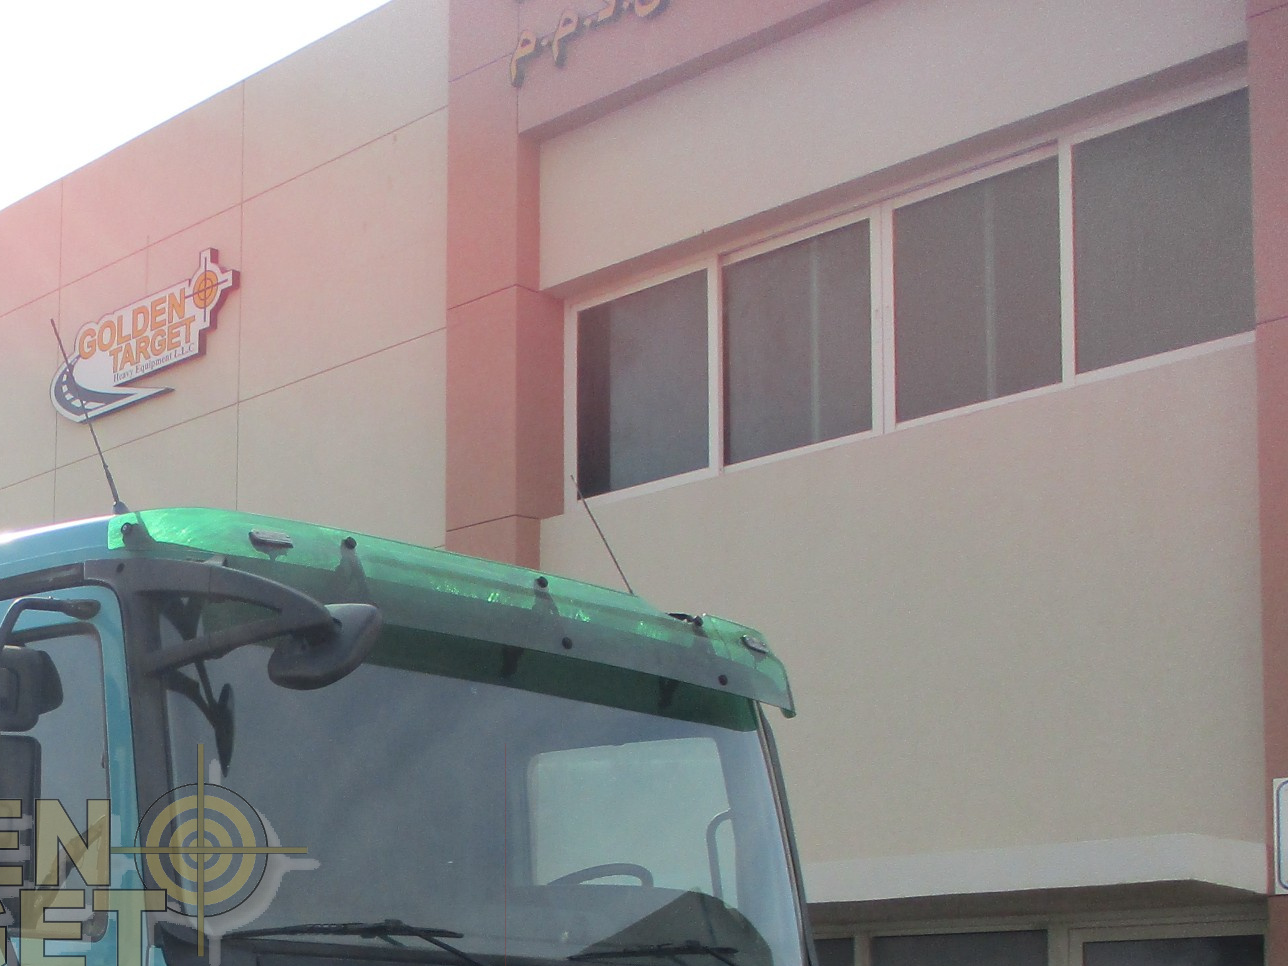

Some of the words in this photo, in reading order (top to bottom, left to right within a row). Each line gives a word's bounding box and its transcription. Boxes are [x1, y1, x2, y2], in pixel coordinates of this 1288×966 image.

[78, 286, 186, 360] GOLDEN
[109, 315, 196, 374] TARGET
[113, 369, 134, 383] Heavy
[135, 352, 172, 374] Equipment
